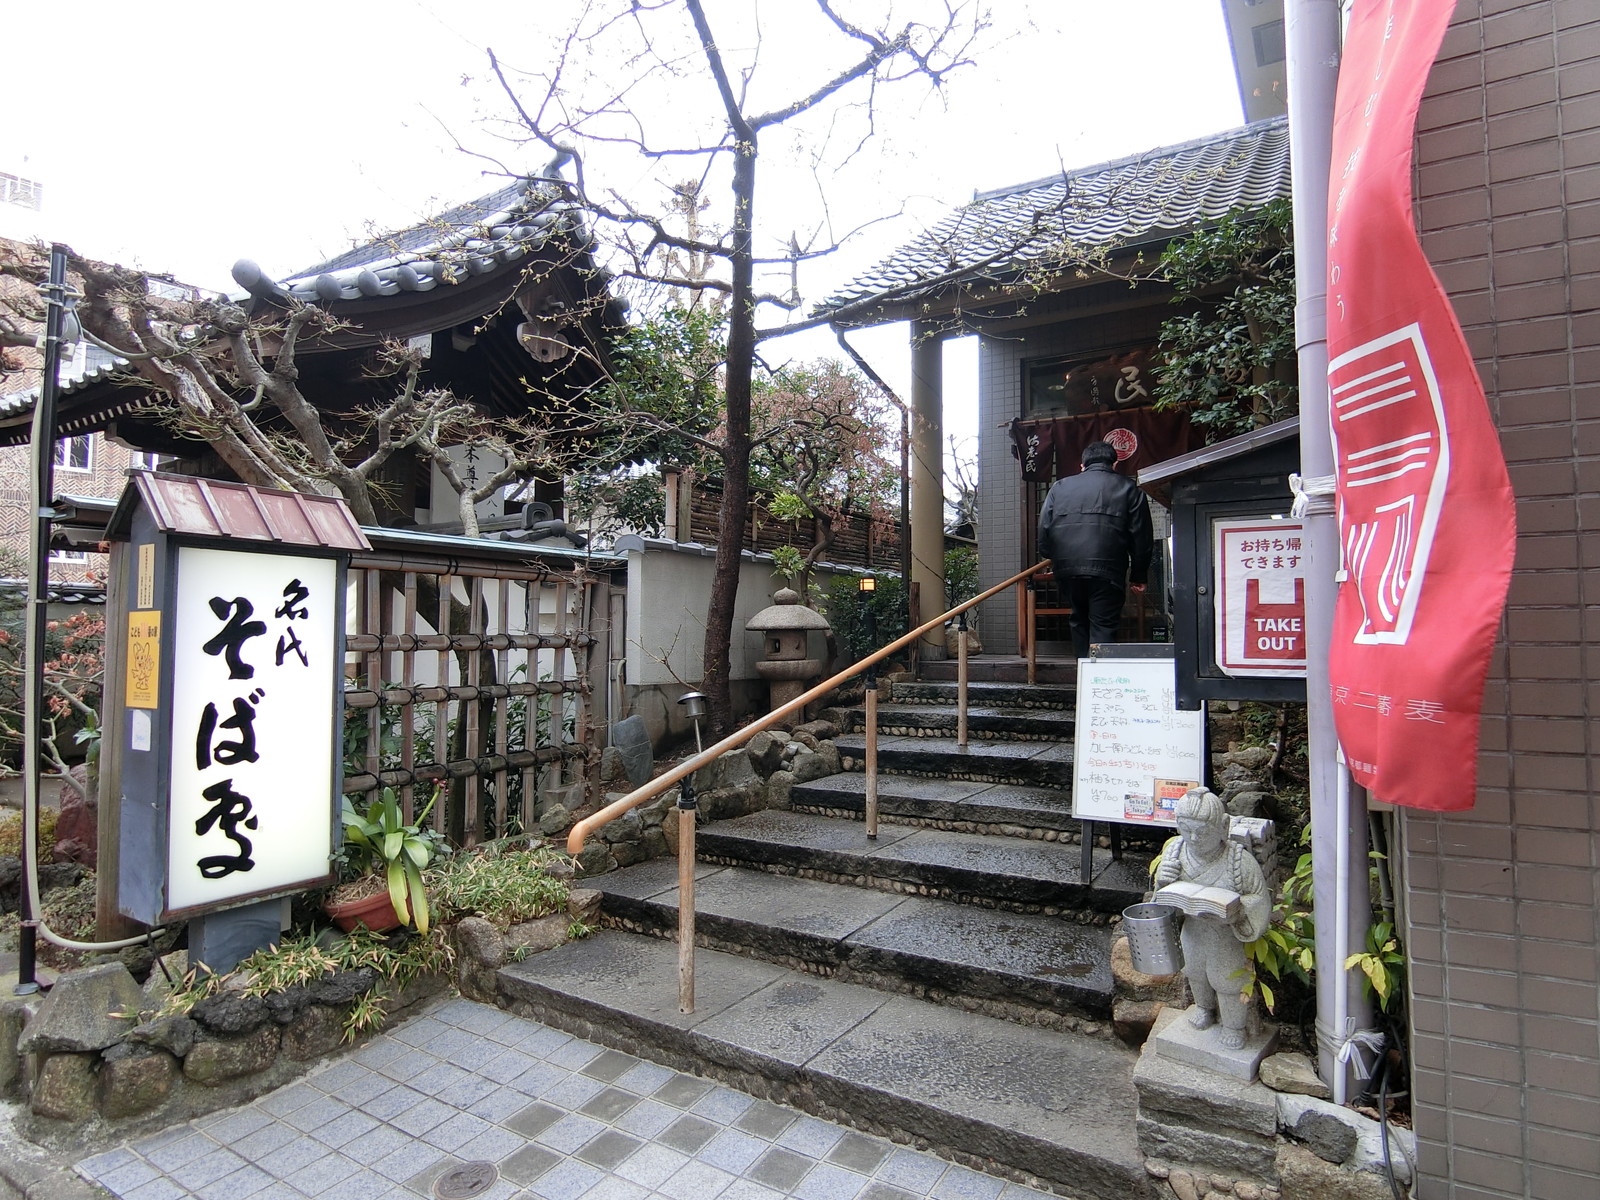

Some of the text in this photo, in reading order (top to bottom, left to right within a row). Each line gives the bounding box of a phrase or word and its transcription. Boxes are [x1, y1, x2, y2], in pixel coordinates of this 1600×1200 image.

[1241, 555, 1302, 569] できます
[1254, 618, 1301, 632] TAKE
[1257, 637, 1296, 650] OUT
